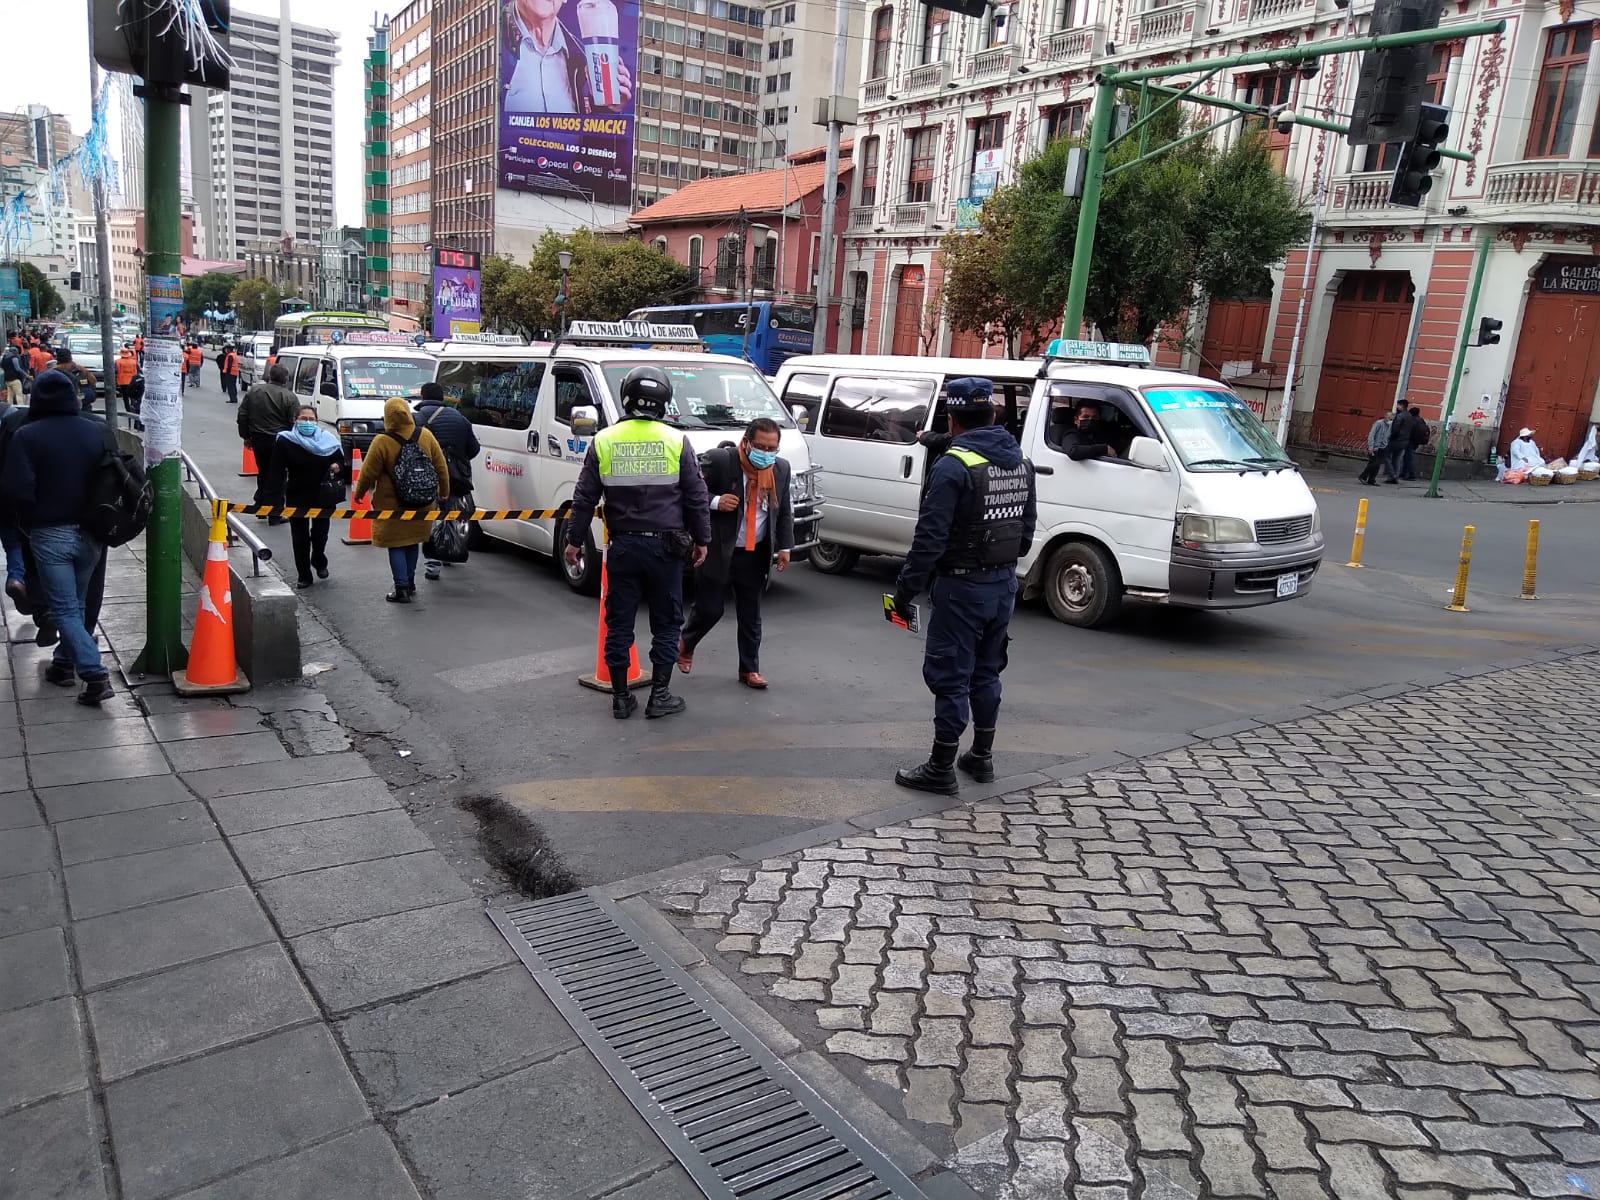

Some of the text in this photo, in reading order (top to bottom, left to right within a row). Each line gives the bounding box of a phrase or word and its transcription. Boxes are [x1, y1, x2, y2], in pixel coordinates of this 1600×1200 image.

[536, 117, 550, 129] LOS
[552, 118, 581, 132] VASOS
[583, 119, 627, 135] SNACK!
[518, 137, 565, 151] COLECCIONA
[566, 144, 580, 153] LOS
[587, 147, 617, 160] DISEÑOS
[548, 160, 569, 170] pepsi
[583, 164, 603, 174] pepsi
[1543, 277, 1600, 292] LA REPUB
[436, 295, 478, 309] TU LUGAR
[577, 323, 587, 335] V.
[587, 323, 622, 336] TUNARI
[623, 320, 650, 338] 940
[657, 327, 667, 337] DE
[668, 328, 694, 338] AGOSTO
[1096, 342, 1111, 359] 361
[612, 442, 664, 457] MOTORIZADO
[612, 460, 668, 474] TRANSPORTE
[988, 477, 1028, 492] MUNICIPAL
[983, 491, 1029, 506] TRANSPORTE
